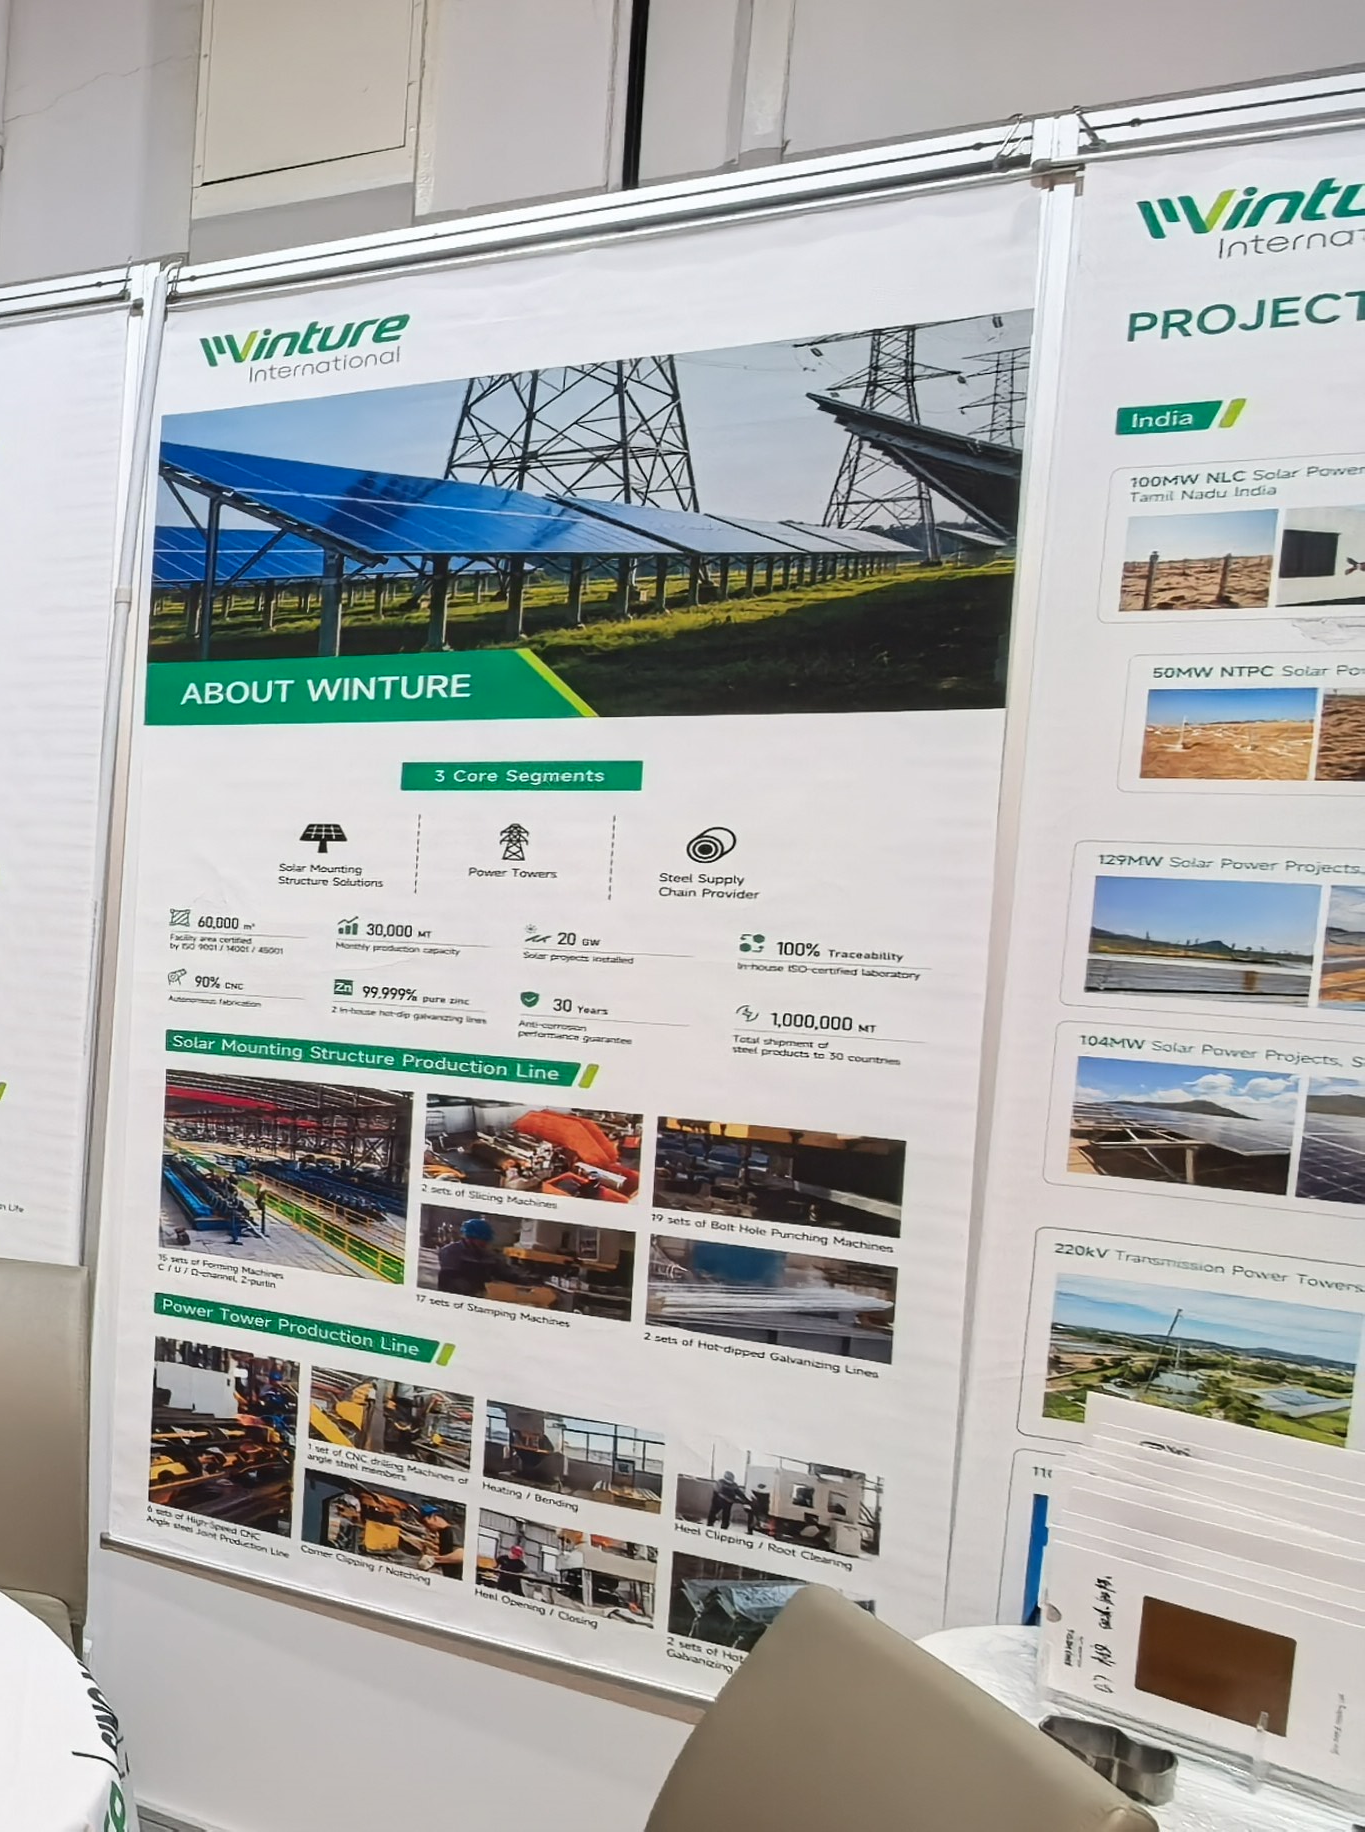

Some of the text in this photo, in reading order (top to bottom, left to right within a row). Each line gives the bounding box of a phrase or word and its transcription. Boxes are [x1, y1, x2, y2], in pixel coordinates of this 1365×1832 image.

[200, 314, 410, 367] Winture
[249, 346, 400, 383] International
[1132, 411, 1193, 428] India
[1130, 468, 1298, 488] 100MW NLC Solar
[1131, 485, 1277, 502] Tamil Nadu India
[1153, 664, 1332, 679] 50MW NTPC Solar
[181, 674, 472, 705] ABOUT WINTURE
[435, 769, 605, 785] 3 Core Segments
[279, 863, 362, 876] Solar Mounting
[1098, 853, 1277, 872] 129MW Solar Power
[469, 867, 558, 879] Power Towers
[659, 873, 745, 887] Steel Supply
[278, 876, 383, 888] Structure Solutions
[659, 887, 759, 901] Chain Provider
[197, 916, 239, 931] 60,000
[366, 924, 413, 938] 30,000
[557, 932, 601, 947] 20 GW
[776, 942, 904, 963] 100% Traceability
[195, 976, 221, 989] 90%
[335, 982, 352, 993] Zn
[362, 986, 417, 1002] 99.999%
[553, 998, 608, 1016] 30 Years
[771, 1012, 853, 1032] 1,000,000
[1079, 1034, 1195, 1055] 104MW Solar
[173, 1035, 559, 1080] Solar Mounting Structure Production Line
[507, 1195, 557, 1210] Machines
[711, 1220, 894, 1254] Bolt Hole Punching Machines
[1055, 1243, 1288, 1283] 220kV Transmission Power
[467, 1303, 570, 1329] Stamping Machines
[162, 1299, 420, 1356] Power Tower Production Line
[770, 1352, 879, 1379] Galvanizing Lines
[482, 1482, 523, 1498] Heating
[675, 1523, 852, 1571] Heel Clipping Root Cleaning
